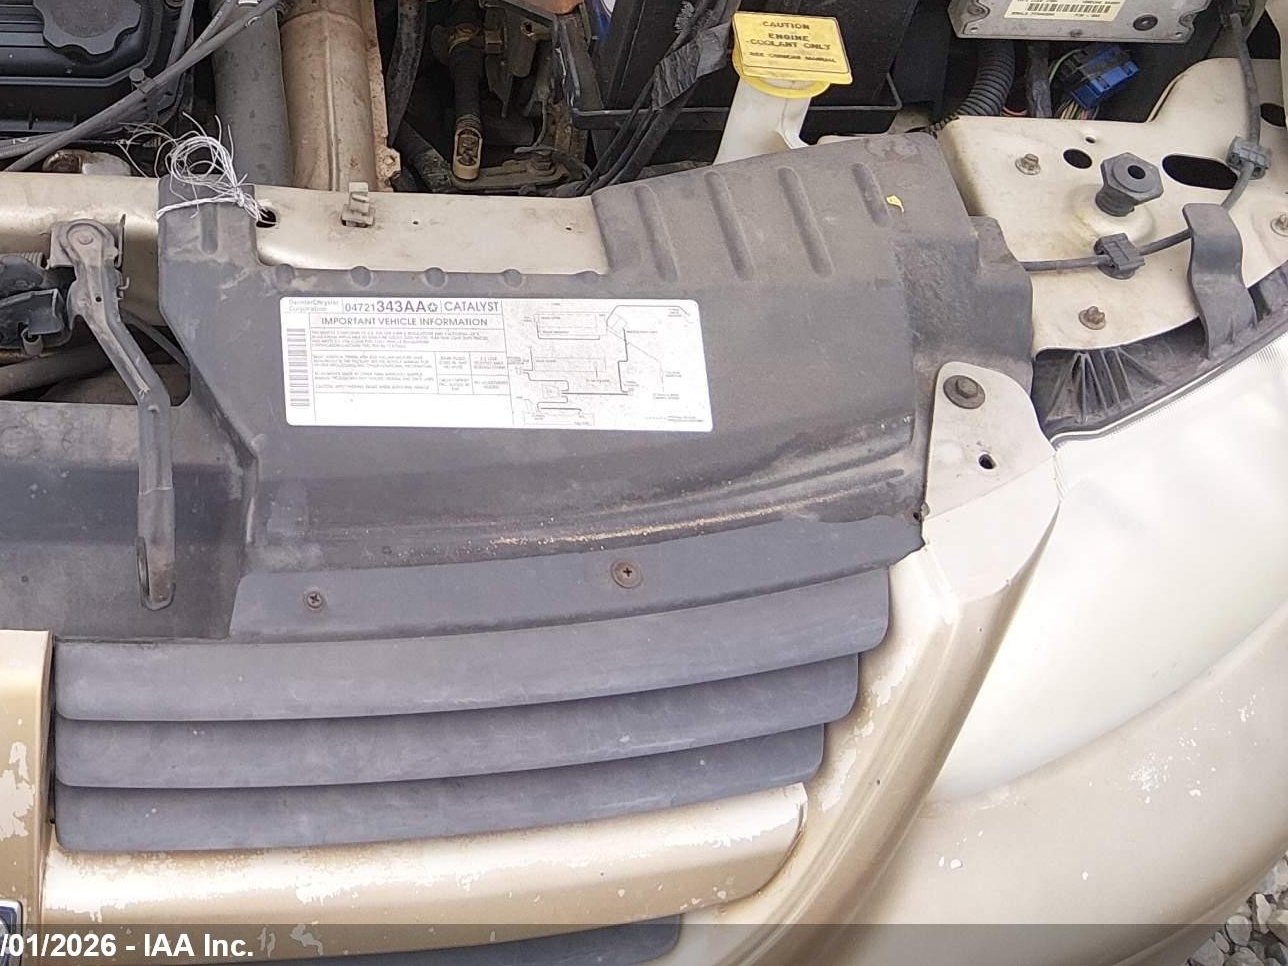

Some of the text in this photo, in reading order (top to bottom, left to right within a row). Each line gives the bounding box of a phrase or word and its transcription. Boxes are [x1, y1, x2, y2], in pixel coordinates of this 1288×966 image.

[762, 21, 810, 30] CAUTION
[768, 33, 809, 41] ENGINE
[750, 38, 798, 48] COOLANT
[444, 301, 499, 312] CATALYST
